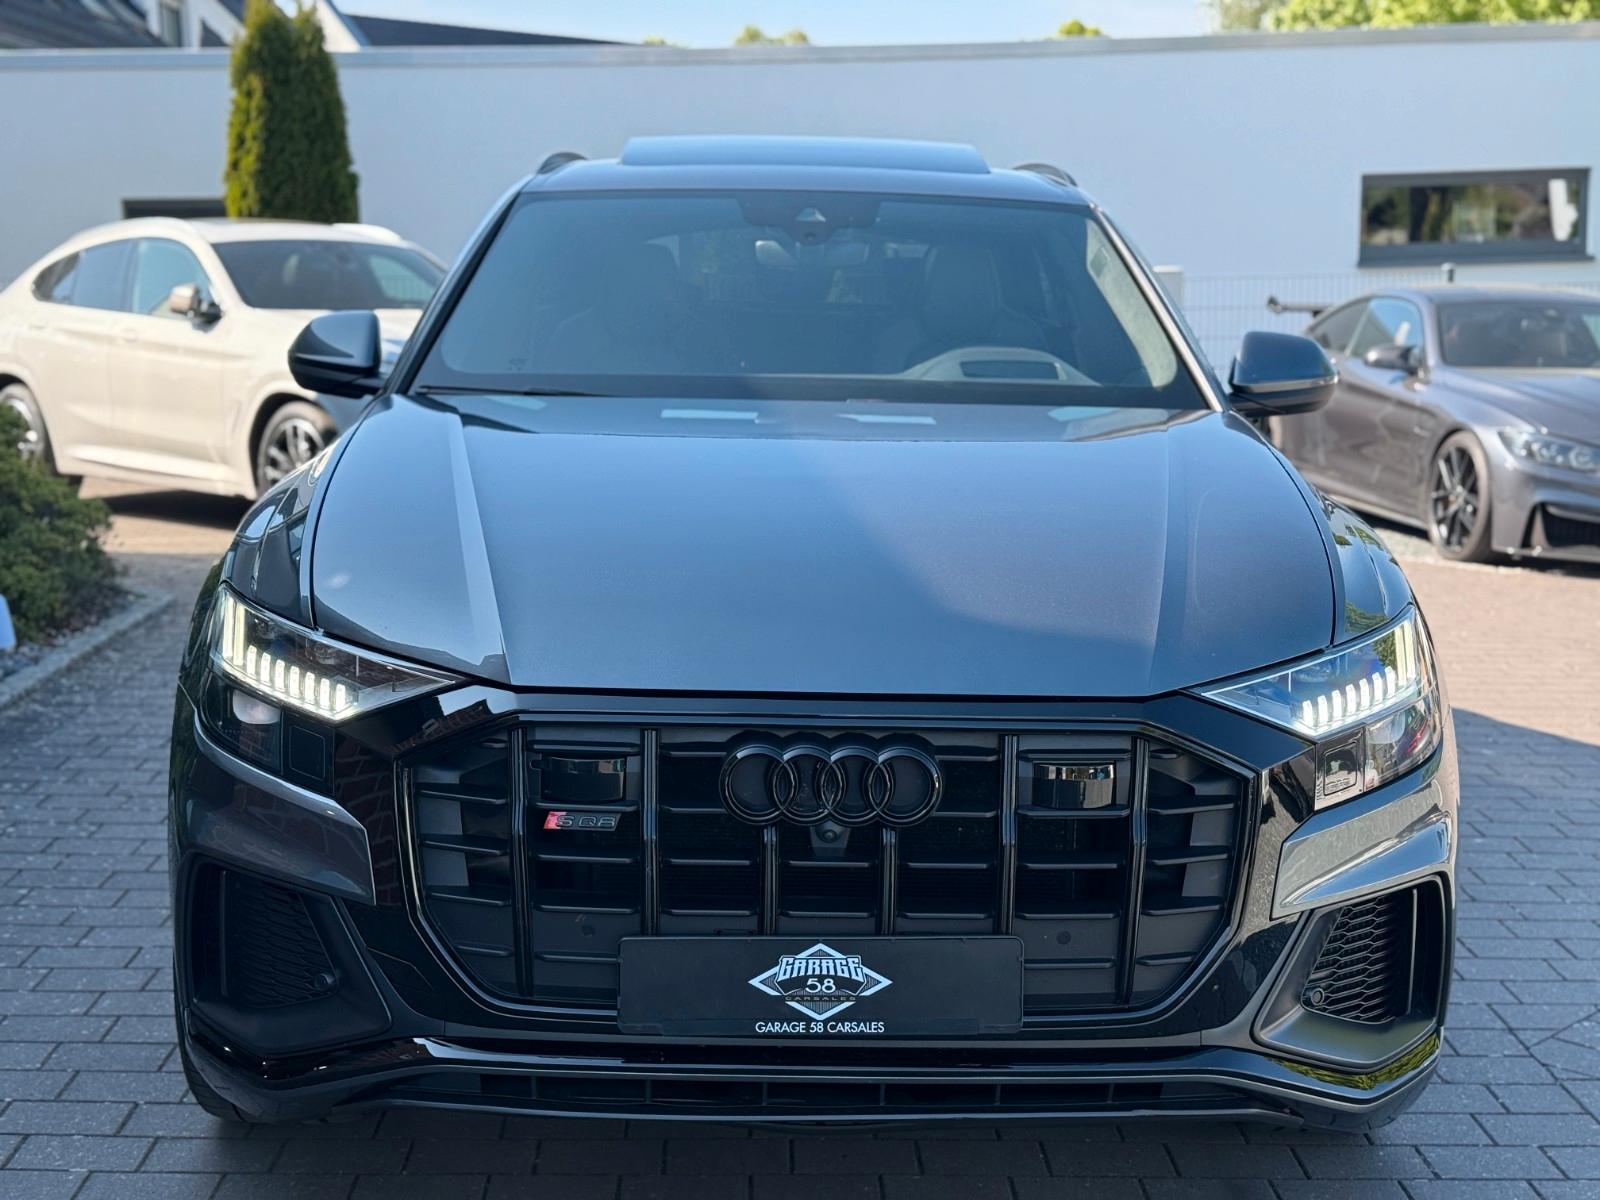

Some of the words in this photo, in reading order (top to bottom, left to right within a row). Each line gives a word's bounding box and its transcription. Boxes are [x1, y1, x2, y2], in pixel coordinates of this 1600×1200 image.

[556, 815, 617, 828] SQ8
[777, 957, 865, 983] GARAGE
[805, 978, 836, 993] 58
[755, 1021, 806, 1033] GARAGE
[809, 1021, 824, 1033] 58
[827, 1021, 885, 1033] CARSALES
